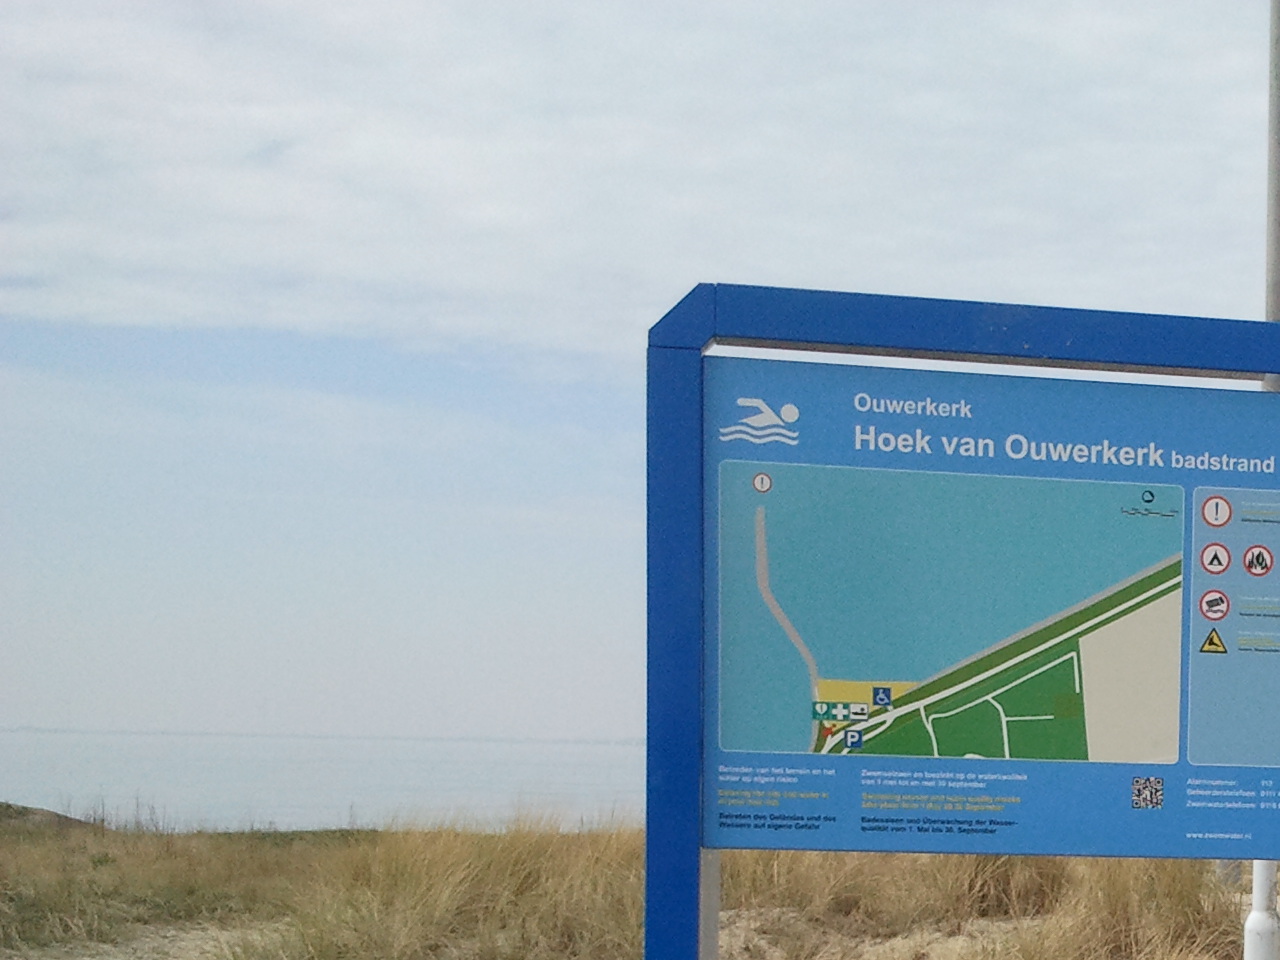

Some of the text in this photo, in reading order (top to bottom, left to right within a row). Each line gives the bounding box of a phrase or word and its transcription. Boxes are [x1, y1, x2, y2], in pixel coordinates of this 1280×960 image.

[853, 392, 973, 418] Ouwerkerk
[854, 425, 1276, 473] Hoek van Ouwerkerk badstrand
[846, 731, 860, 747] P
